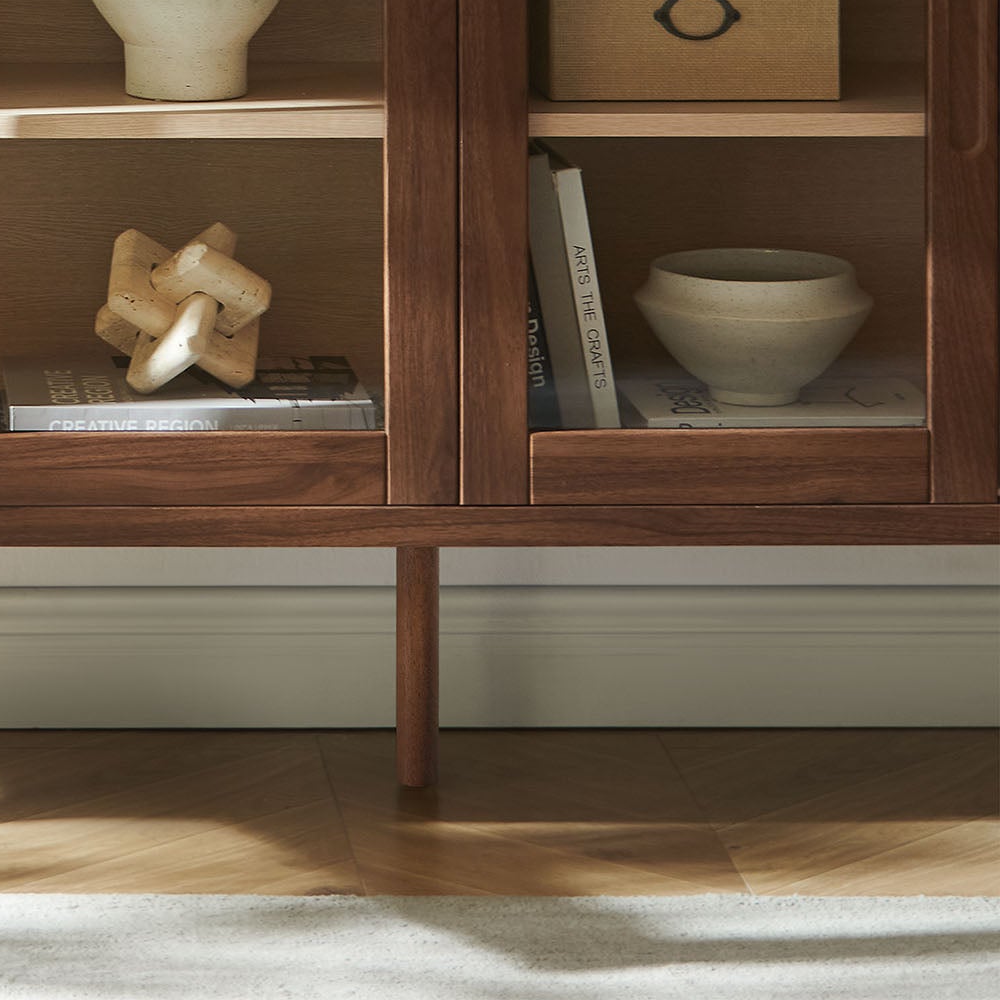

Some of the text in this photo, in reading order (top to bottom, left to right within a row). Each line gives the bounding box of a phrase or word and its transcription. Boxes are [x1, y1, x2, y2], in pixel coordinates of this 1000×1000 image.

[572, 244, 608, 390] ARTS THE CRAFTS
[43, 369, 81, 405] CREATIVE
[80, 375, 118, 405] REGION
[49, 419, 138, 431] CREATIVE
[145, 419, 219, 431] REGION
